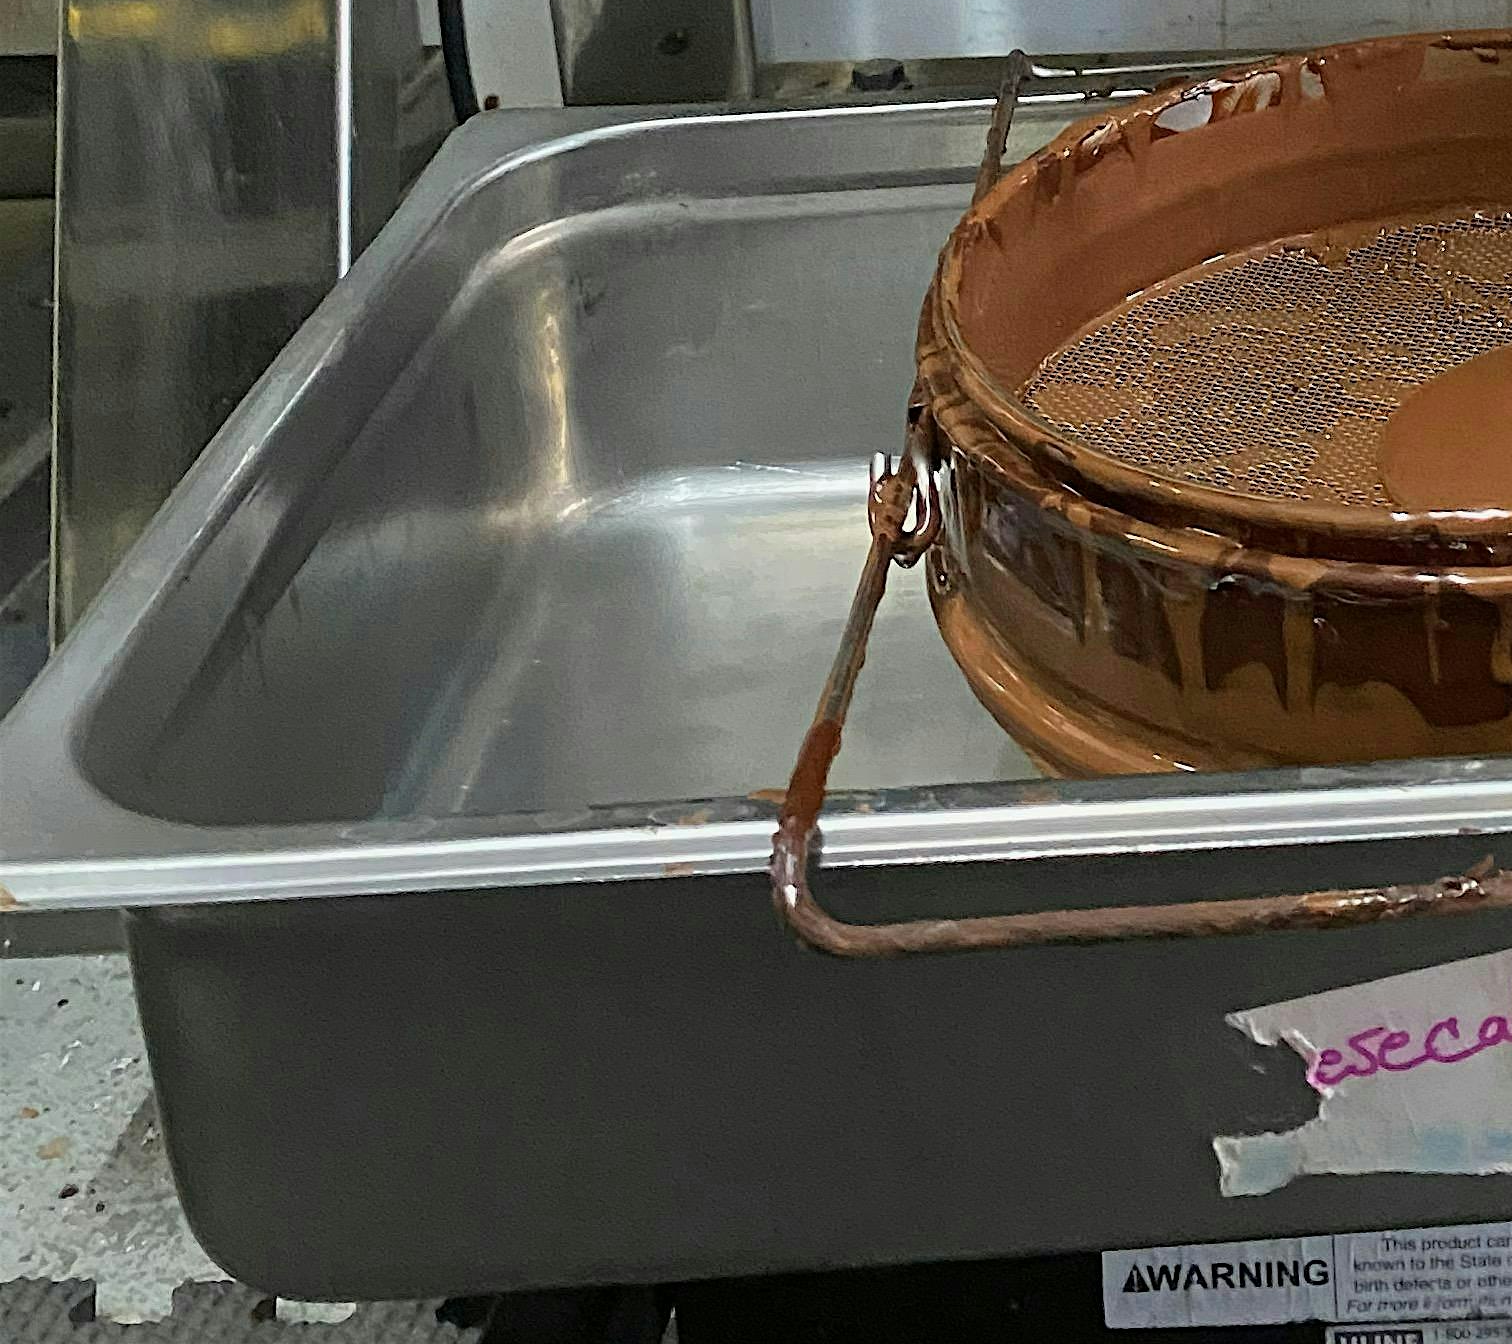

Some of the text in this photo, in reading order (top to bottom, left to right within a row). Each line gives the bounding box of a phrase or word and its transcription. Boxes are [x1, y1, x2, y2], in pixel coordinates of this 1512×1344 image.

[1382, 1237, 1416, 1252] This
[1421, 1236, 1481, 1251] product
[1353, 1257, 1406, 1273] known
[1410, 1258, 1426, 1271] to
[1429, 1255, 1455, 1271] the
[1460, 1254, 1502, 1269] State
[1146, 1259, 1329, 1291] WARNING
[1354, 1277, 1389, 1294] birth
[1393, 1275, 1452, 1292] defects
[1456, 1278, 1473, 1290] or
[1347, 1298, 1373, 1313] For
